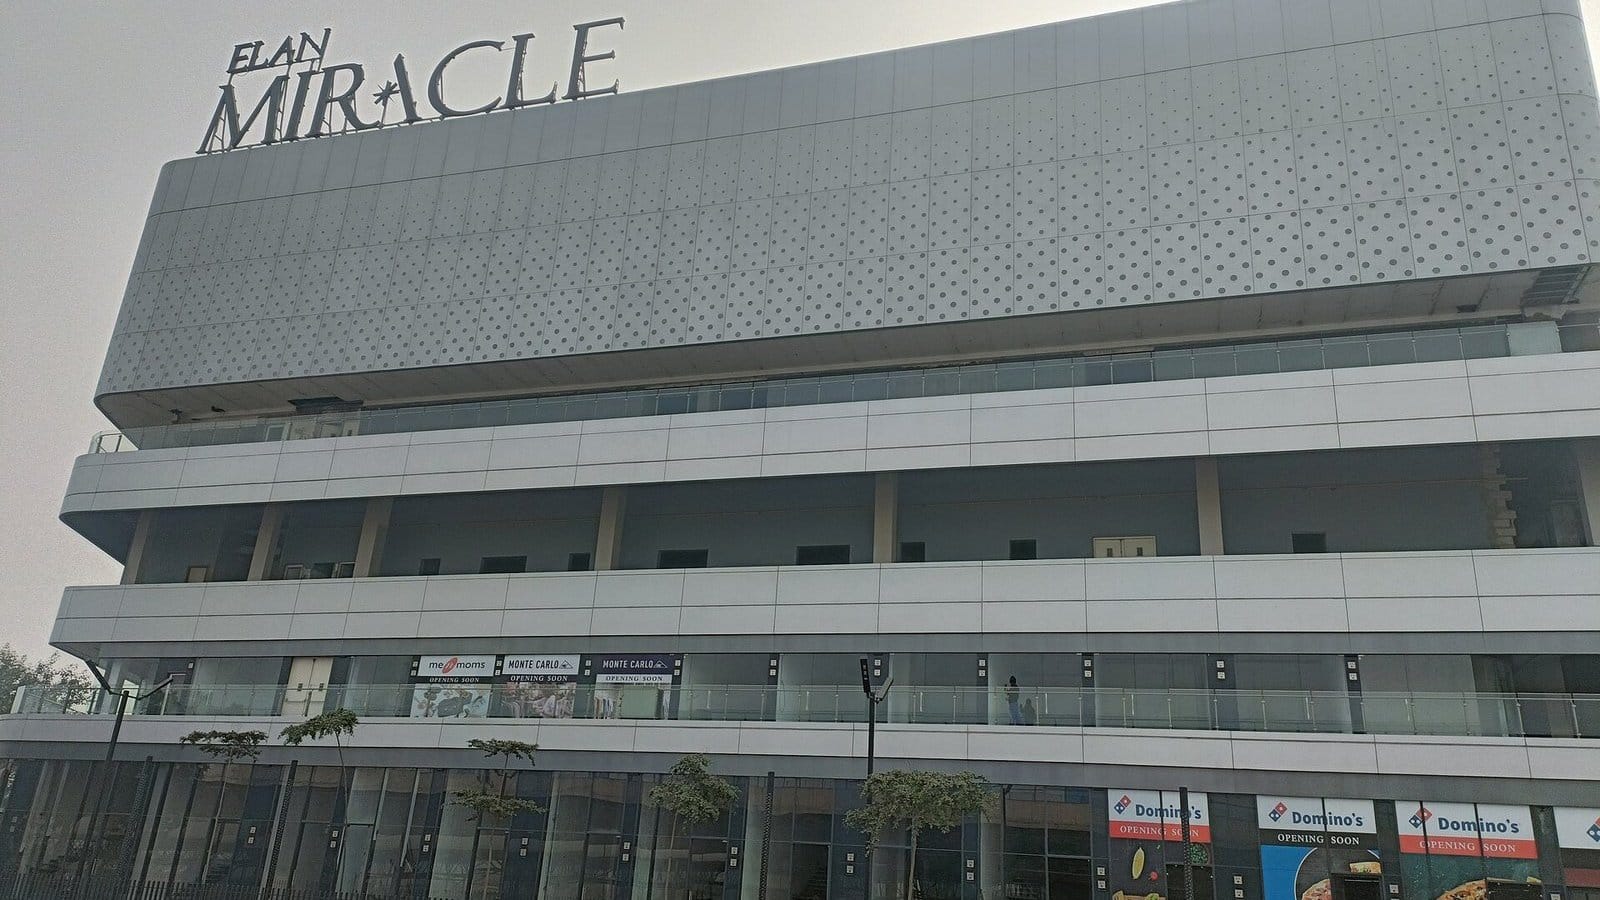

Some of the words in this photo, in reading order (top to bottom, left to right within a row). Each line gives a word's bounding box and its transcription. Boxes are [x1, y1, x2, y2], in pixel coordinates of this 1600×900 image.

[226, 28, 332, 73] ELAN
[196, 17, 625, 154] MIRACLE
[456, 661, 485, 669] moms
[509, 660, 533, 669] MONTE
[536, 660, 559, 669] CARLO
[603, 660, 628, 669] MONTE
[630, 660, 654, 669] CARLO
[1136, 804, 1202, 820] Domin's
[1292, 811, 1363, 827] Domino's
[1438, 817, 1520, 833] Domino's
[1120, 825, 1167, 836] OPENING
[1277, 833, 1324, 844] OPENING
[1330, 836, 1360, 845] SOON
[1419, 840, 1476, 851] OPENING
[1483, 843, 1516, 853] SOON
